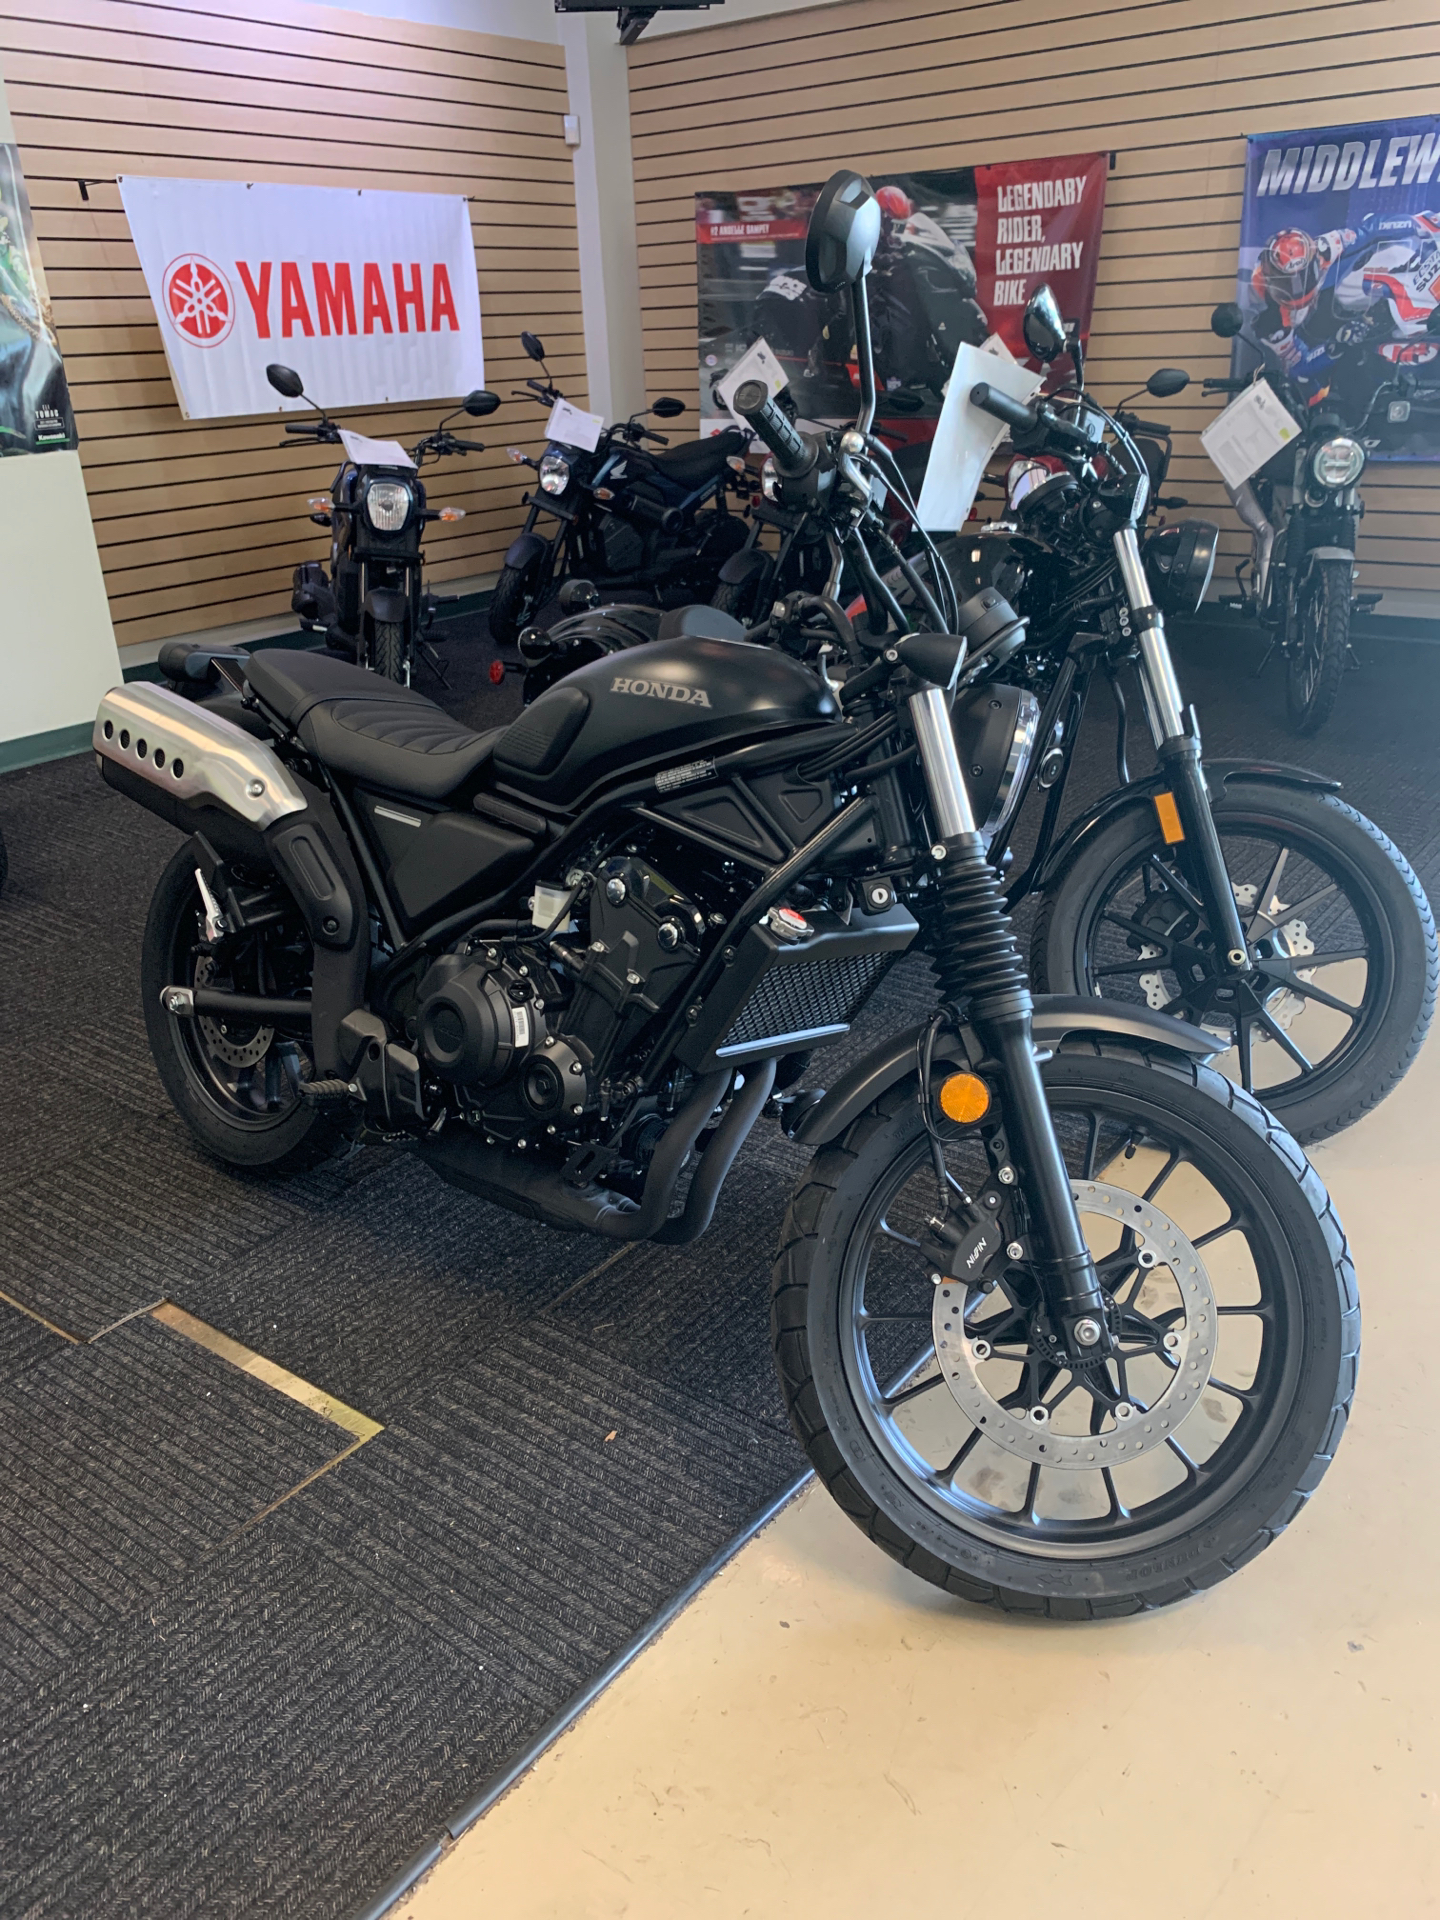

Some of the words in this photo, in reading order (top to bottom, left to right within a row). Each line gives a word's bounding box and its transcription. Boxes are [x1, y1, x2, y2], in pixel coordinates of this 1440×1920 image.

[1256, 133, 1440, 196] MIDDLEW
[997, 176, 1087, 213] LEGENDARY
[996, 215, 1046, 244] RIDER,
[995, 241, 1084, 275] LEGENDARY
[235, 261, 460, 339] YAMAHA
[993, 279, 1027, 306] BIKE
[35, 409, 59, 419] TOMAC
[610, 677, 712, 708] HONDA
